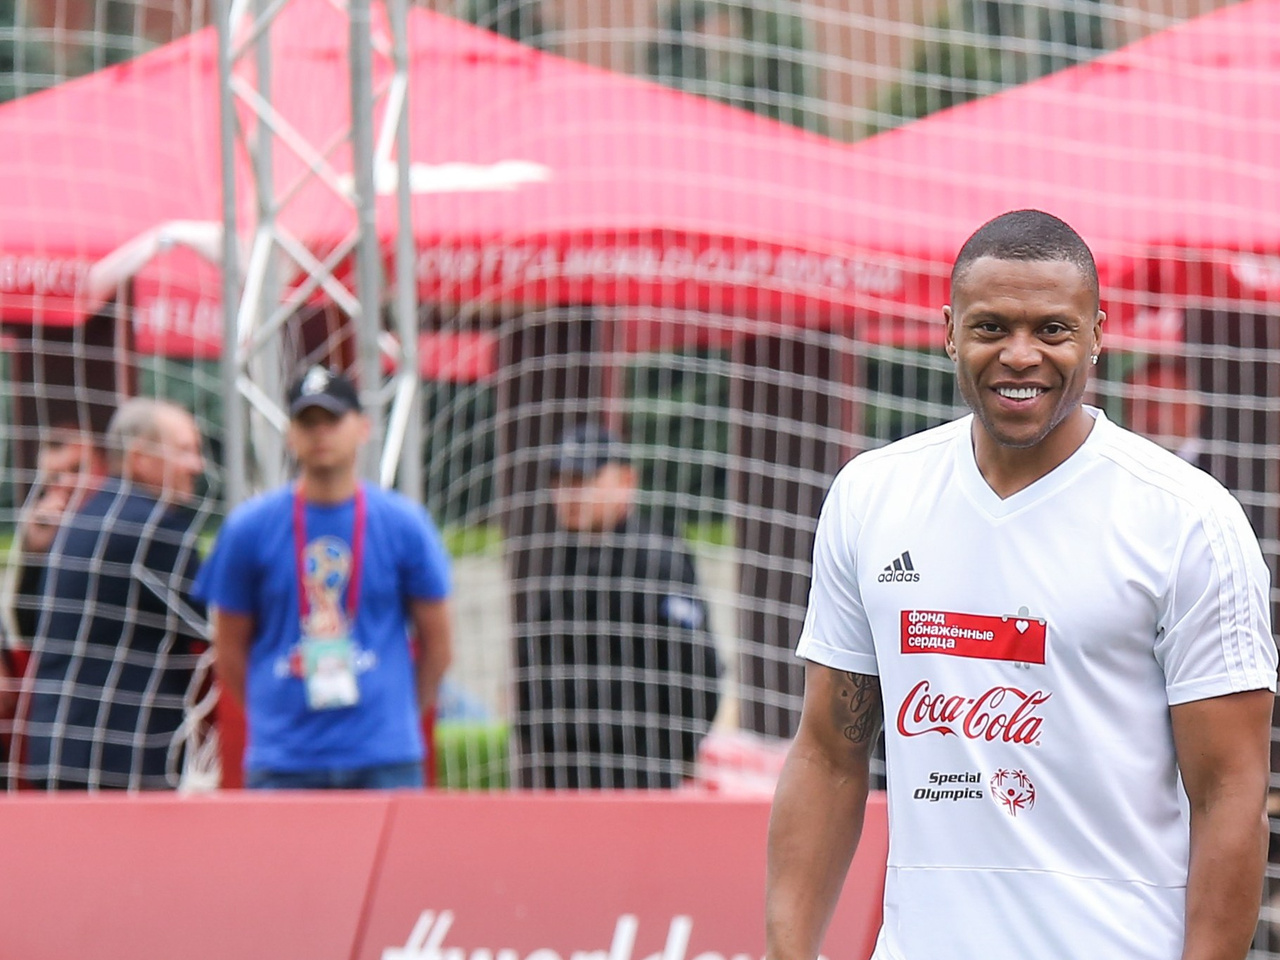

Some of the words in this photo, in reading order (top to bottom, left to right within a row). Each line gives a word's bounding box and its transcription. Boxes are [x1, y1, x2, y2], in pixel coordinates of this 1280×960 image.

[877, 569, 921, 583] adidas
[908, 610, 945, 625] фонд
[907, 622, 994, 641] обнажённые
[908, 636, 956, 650] сердца
[896, 679, 1054, 745] Coca-Cola
[928, 771, 981, 786] Special
[913, 787, 983, 802] Olympics
